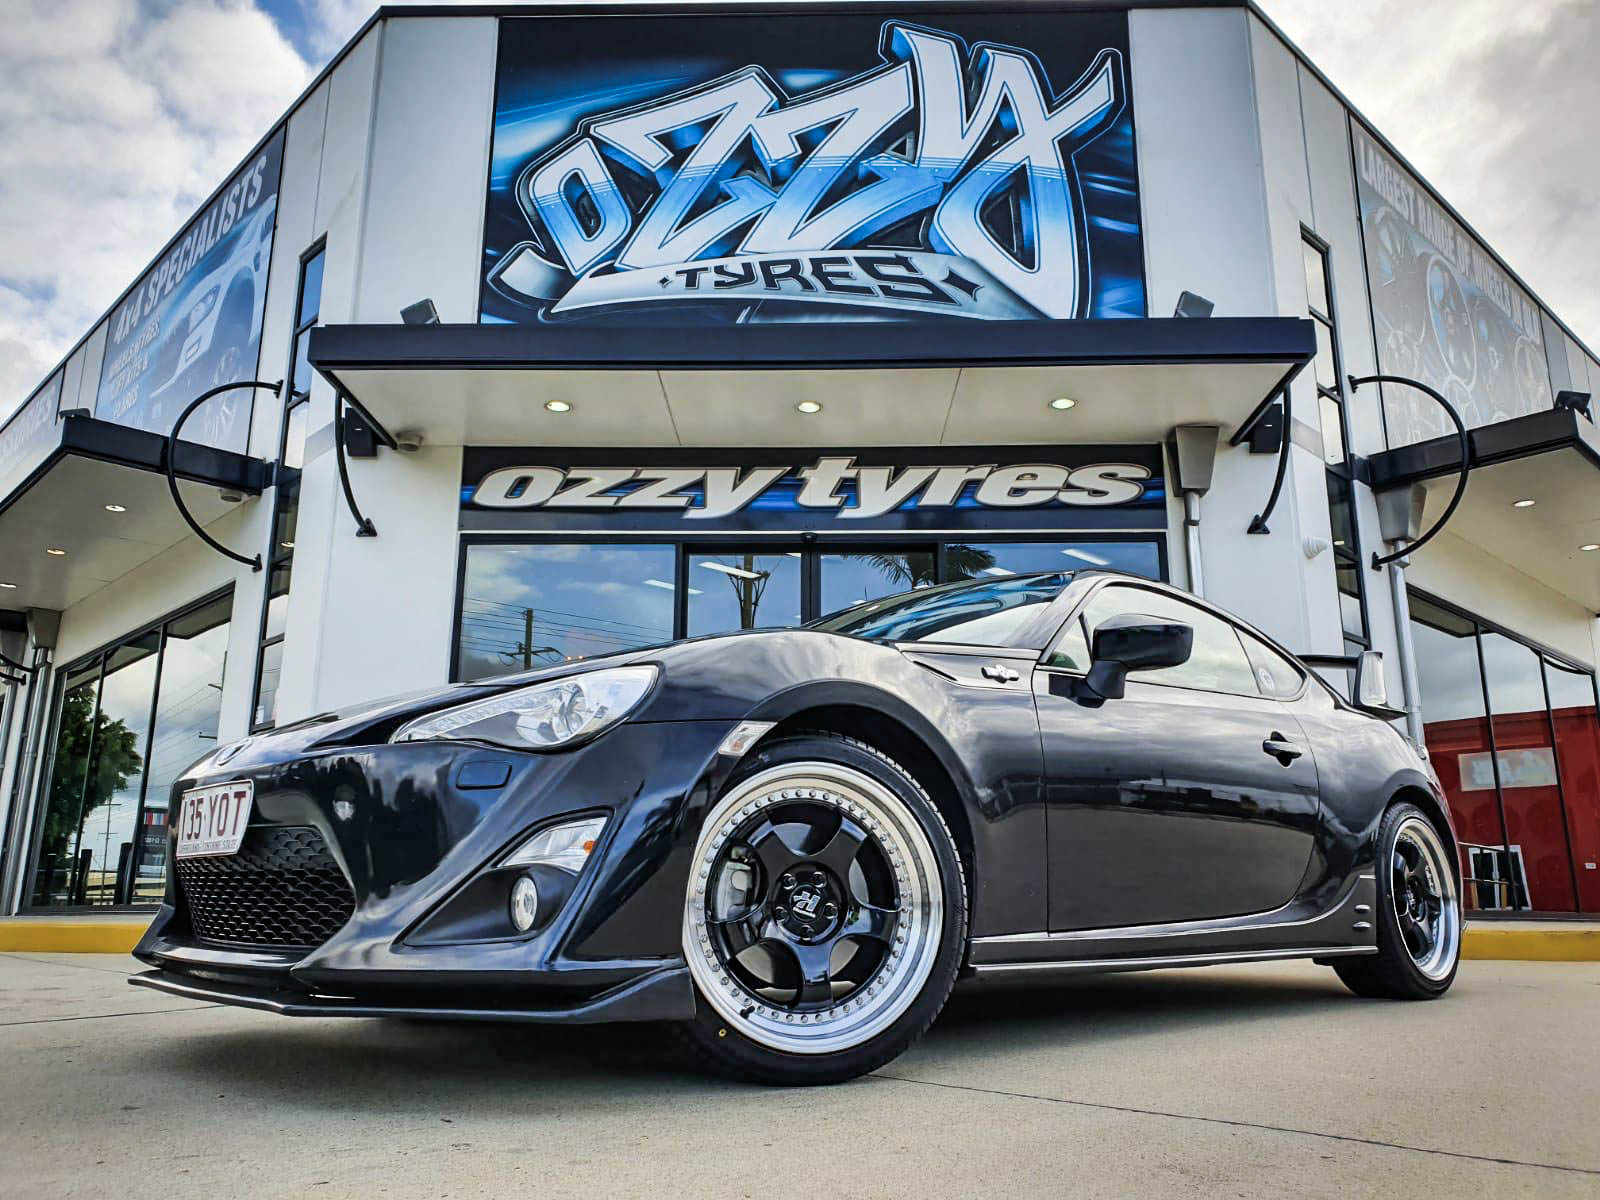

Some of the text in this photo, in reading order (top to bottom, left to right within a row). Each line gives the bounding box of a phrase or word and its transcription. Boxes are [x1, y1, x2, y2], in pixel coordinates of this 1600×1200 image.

[144, 155, 267, 315] SPECIALISTS
[1360, 137, 1416, 226] LARGEST
[1416, 192, 1457, 266] RANGE
[677, 256, 961, 306] TYRES
[473, 456, 1152, 519] ozzy tyres
